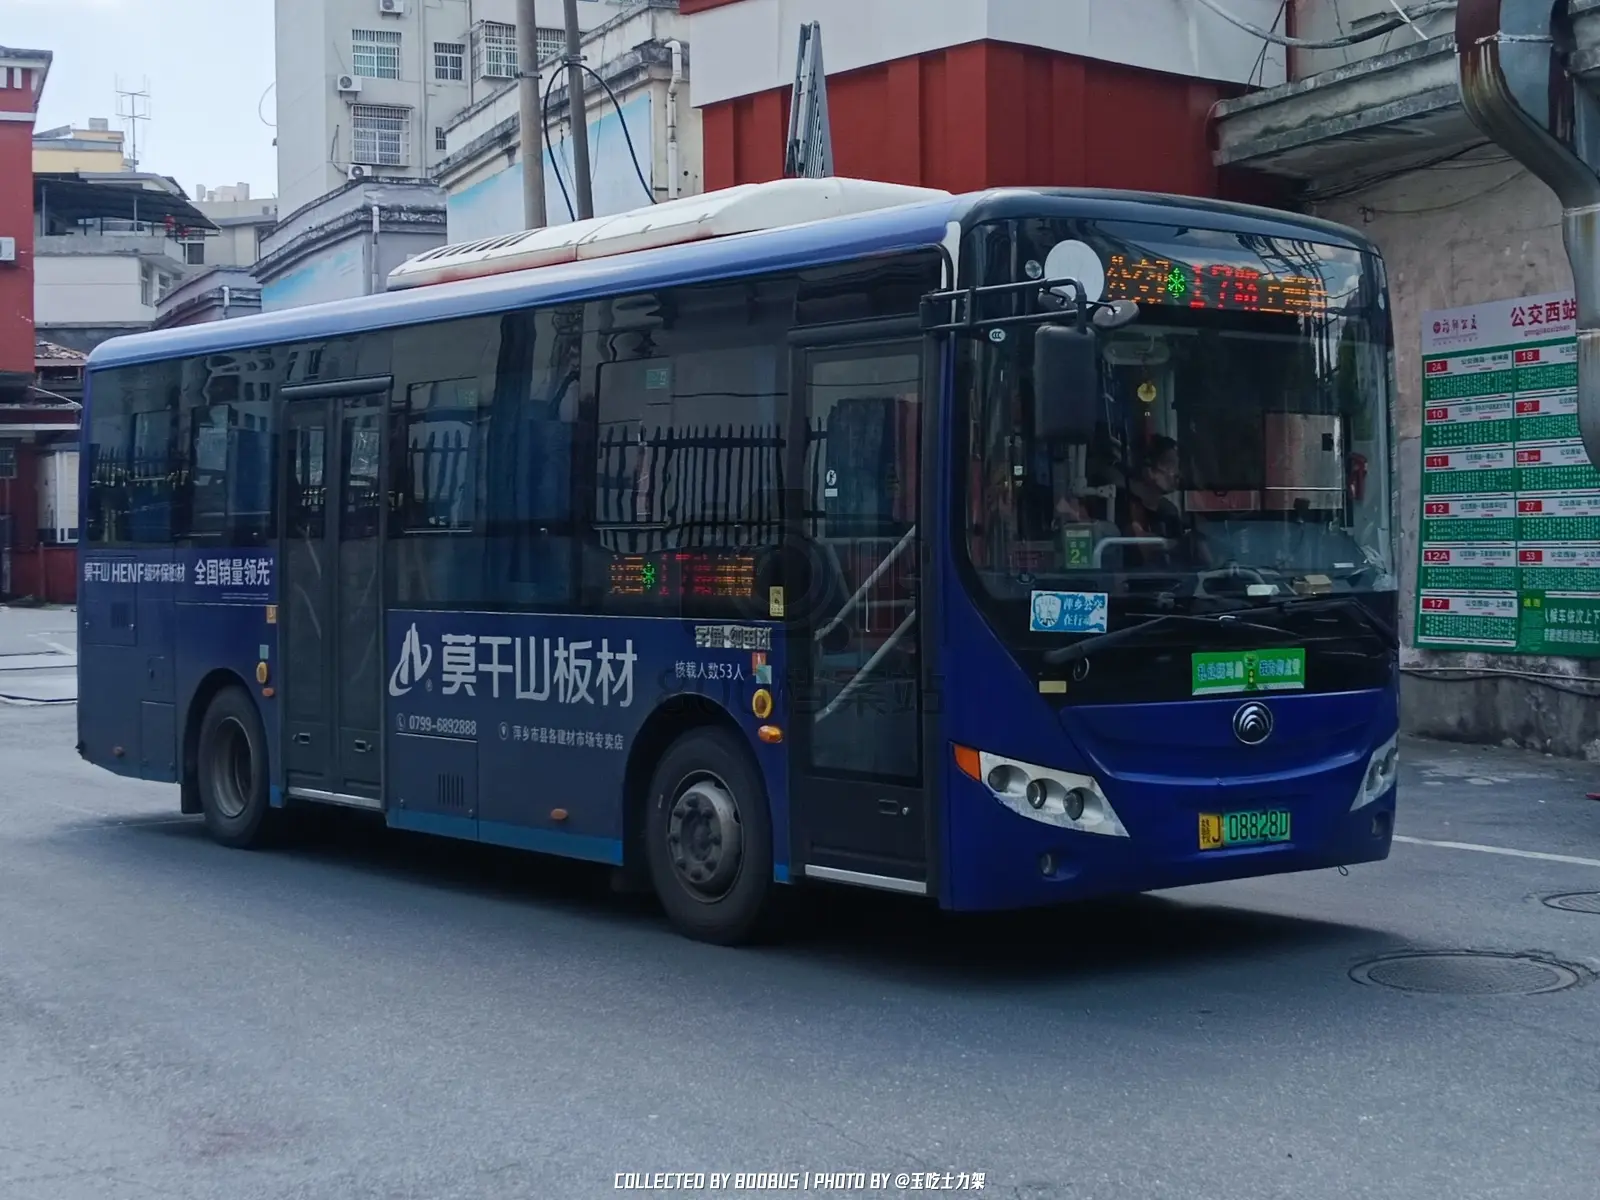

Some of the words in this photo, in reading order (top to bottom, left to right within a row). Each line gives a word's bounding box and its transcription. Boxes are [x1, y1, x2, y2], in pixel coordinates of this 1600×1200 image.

[1511, 298, 1576, 327] 公交西站
[1521, 351, 1533, 361] 18
[1523, 402, 1533, 412] 20
[1431, 409, 1443, 419] 10
[1433, 457, 1443, 467] 11
[1431, 504, 1444, 514] 12
[1525, 501, 1535, 512] 27
[1426, 551, 1448, 561] 12A
[1526, 551, 1536, 561] 53
[1430, 599, 1443, 609] 17
[441, 633, 638, 707] 莫干山板材
[675, 660, 744, 681] 核载人数53人
[1229, 810, 1289, 840] 08828D
